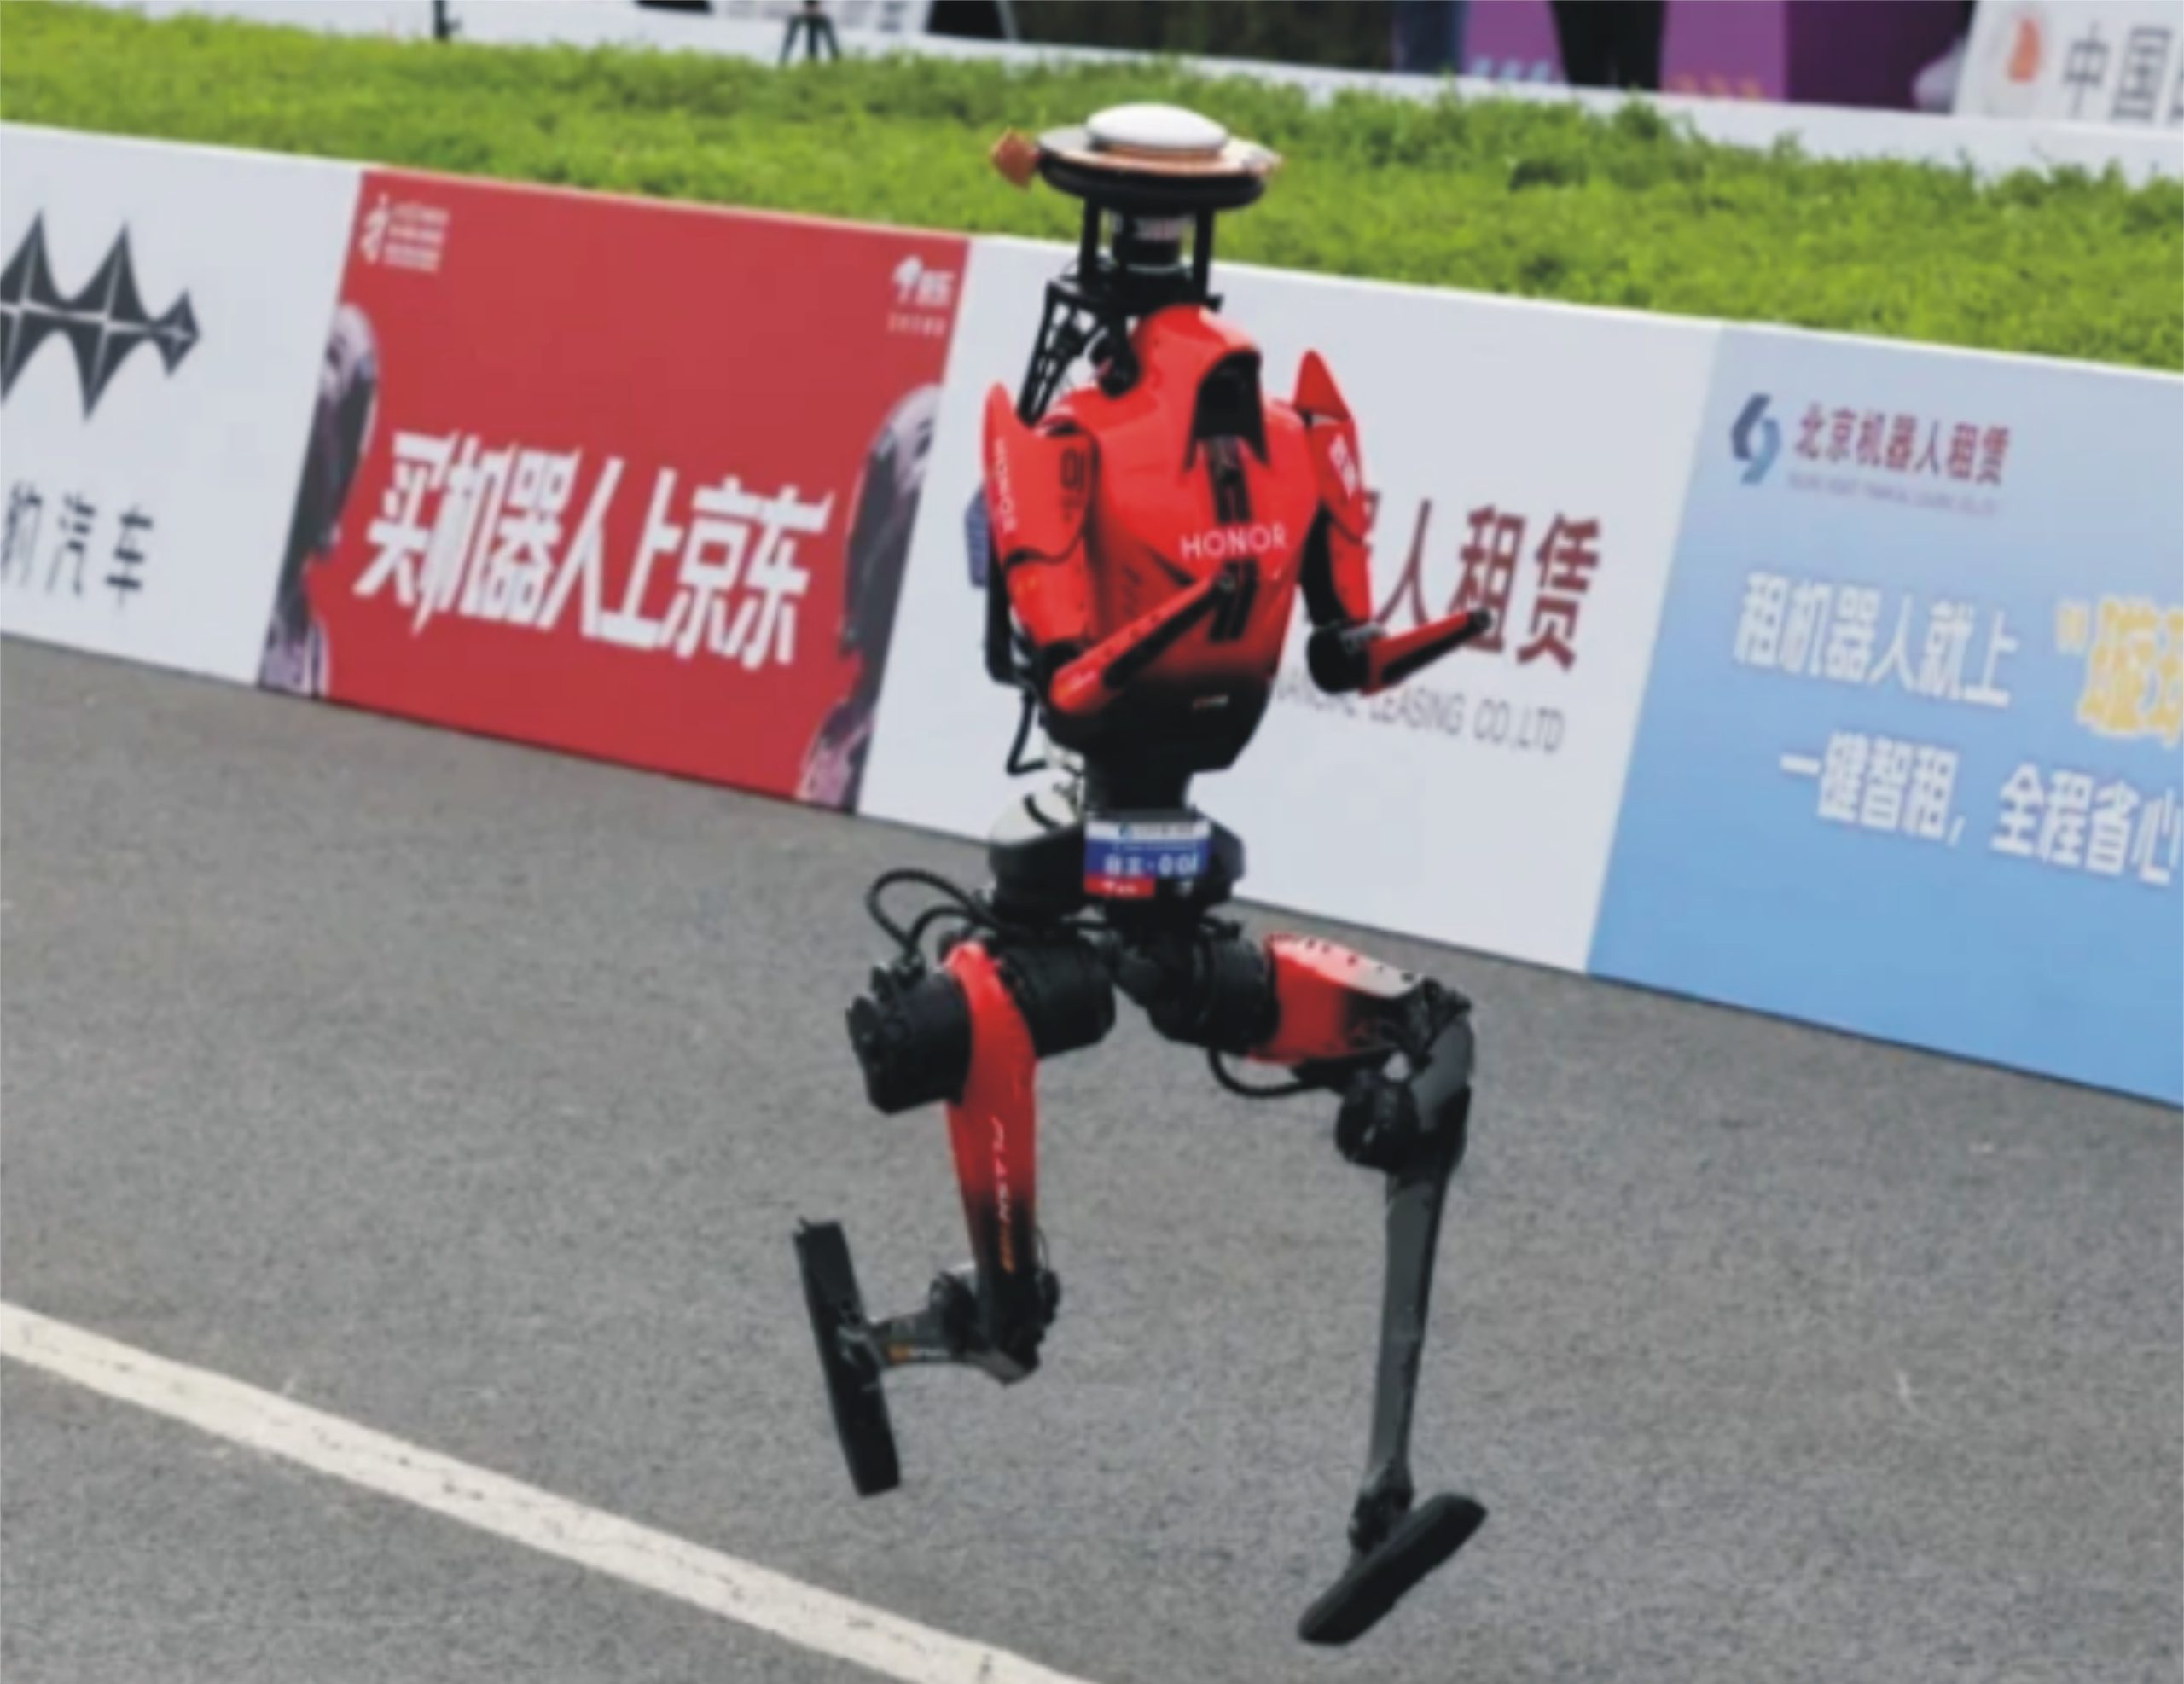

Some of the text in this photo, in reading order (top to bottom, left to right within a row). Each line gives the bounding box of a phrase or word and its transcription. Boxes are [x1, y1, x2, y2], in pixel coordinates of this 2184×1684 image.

[2061, 20, 2183, 125] 中国
[1795, 401, 2011, 487] 北京机器人租赁
[352, 429, 837, 671] 买机器人上京东
[1179, 522, 1287, 560] HONOR
[1362, 489, 1600, 673] 人租赁
[1734, 571, 2018, 708] 租机器人就上
